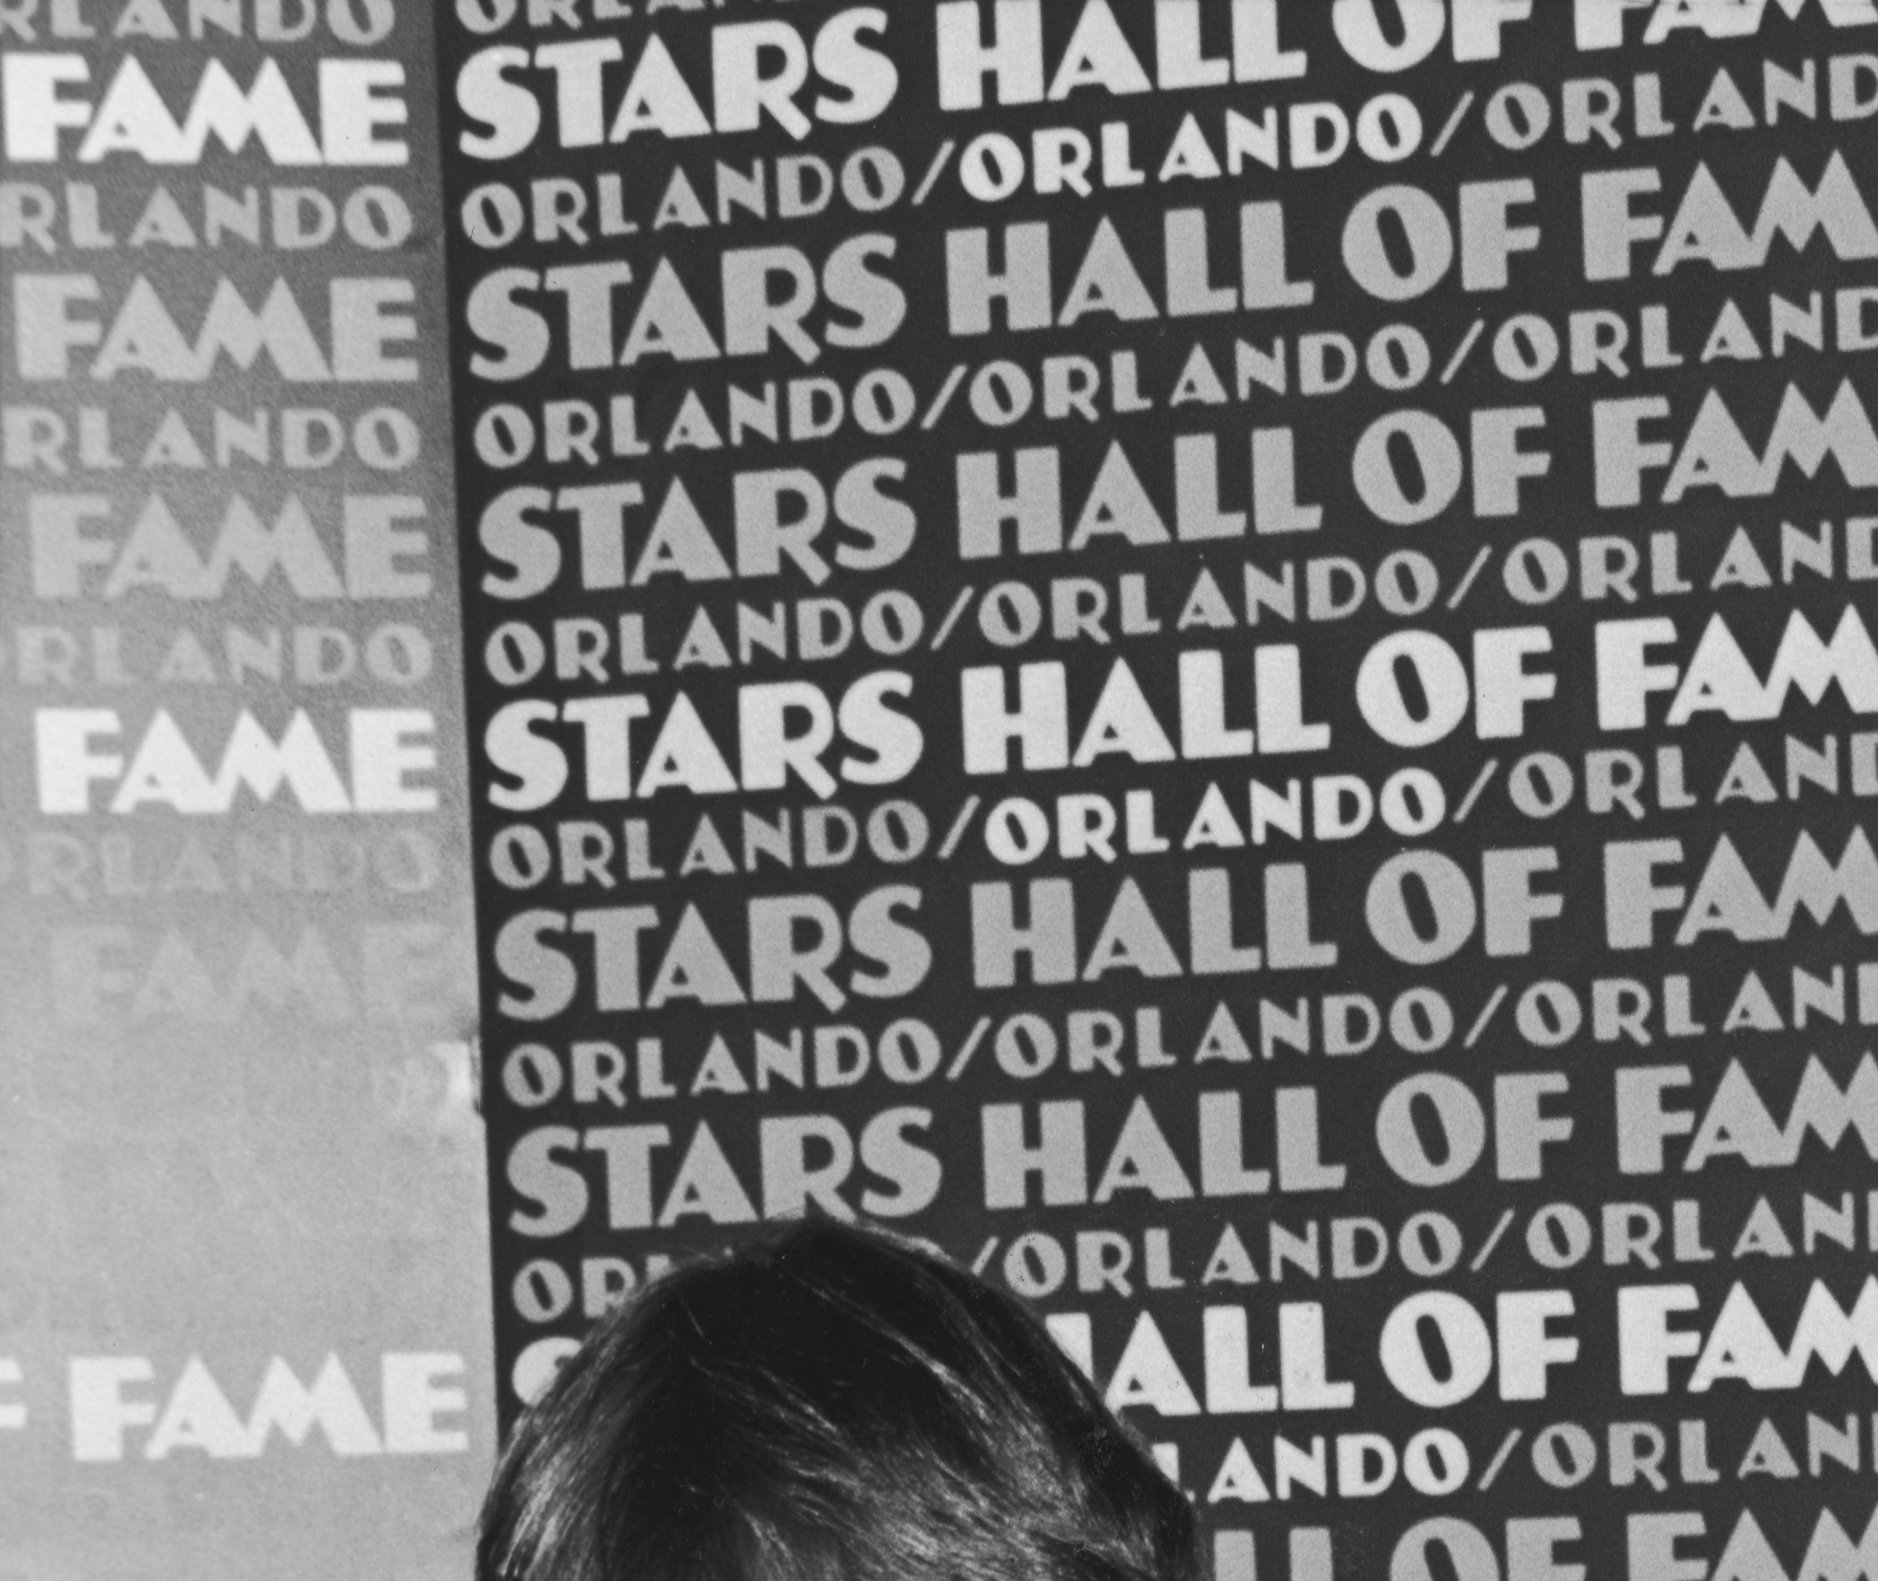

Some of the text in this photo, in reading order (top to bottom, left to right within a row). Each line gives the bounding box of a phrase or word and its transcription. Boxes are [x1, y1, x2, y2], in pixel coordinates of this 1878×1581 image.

[4, 54, 409, 166] FAME
[457, 8, 898, 159] STARS
[937, 0, 1306, 110] HALL
[15, 275, 419, 383] FAME
[467, 233, 906, 380] STARS
[946, 201, 1314, 335] HALL
[1342, 179, 1540, 300] OF
[29, 493, 432, 600] FAME
[480, 458, 916, 599] STARS
[957, 427, 1322, 558] HALL
[1352, 407, 1550, 524] OF
[34, 708, 440, 815] FAME
[486, 671, 923, 810] STARS
[962, 644, 1330, 774] HALL
[1356, 626, 1556, 747] OF
[496, 885, 931, 1019] STARS
[972, 864, 1337, 987] HALL
[1365, 847, 1563, 964] OF
[509, 1107, 941, 1235] STARS
[982, 1087, 1346, 1209] HALL
[1376, 1073, 1573, 1186] OF
[69, 1351, 469, 1462] FAME
[1380, 1290, 1578, 1407] OF
